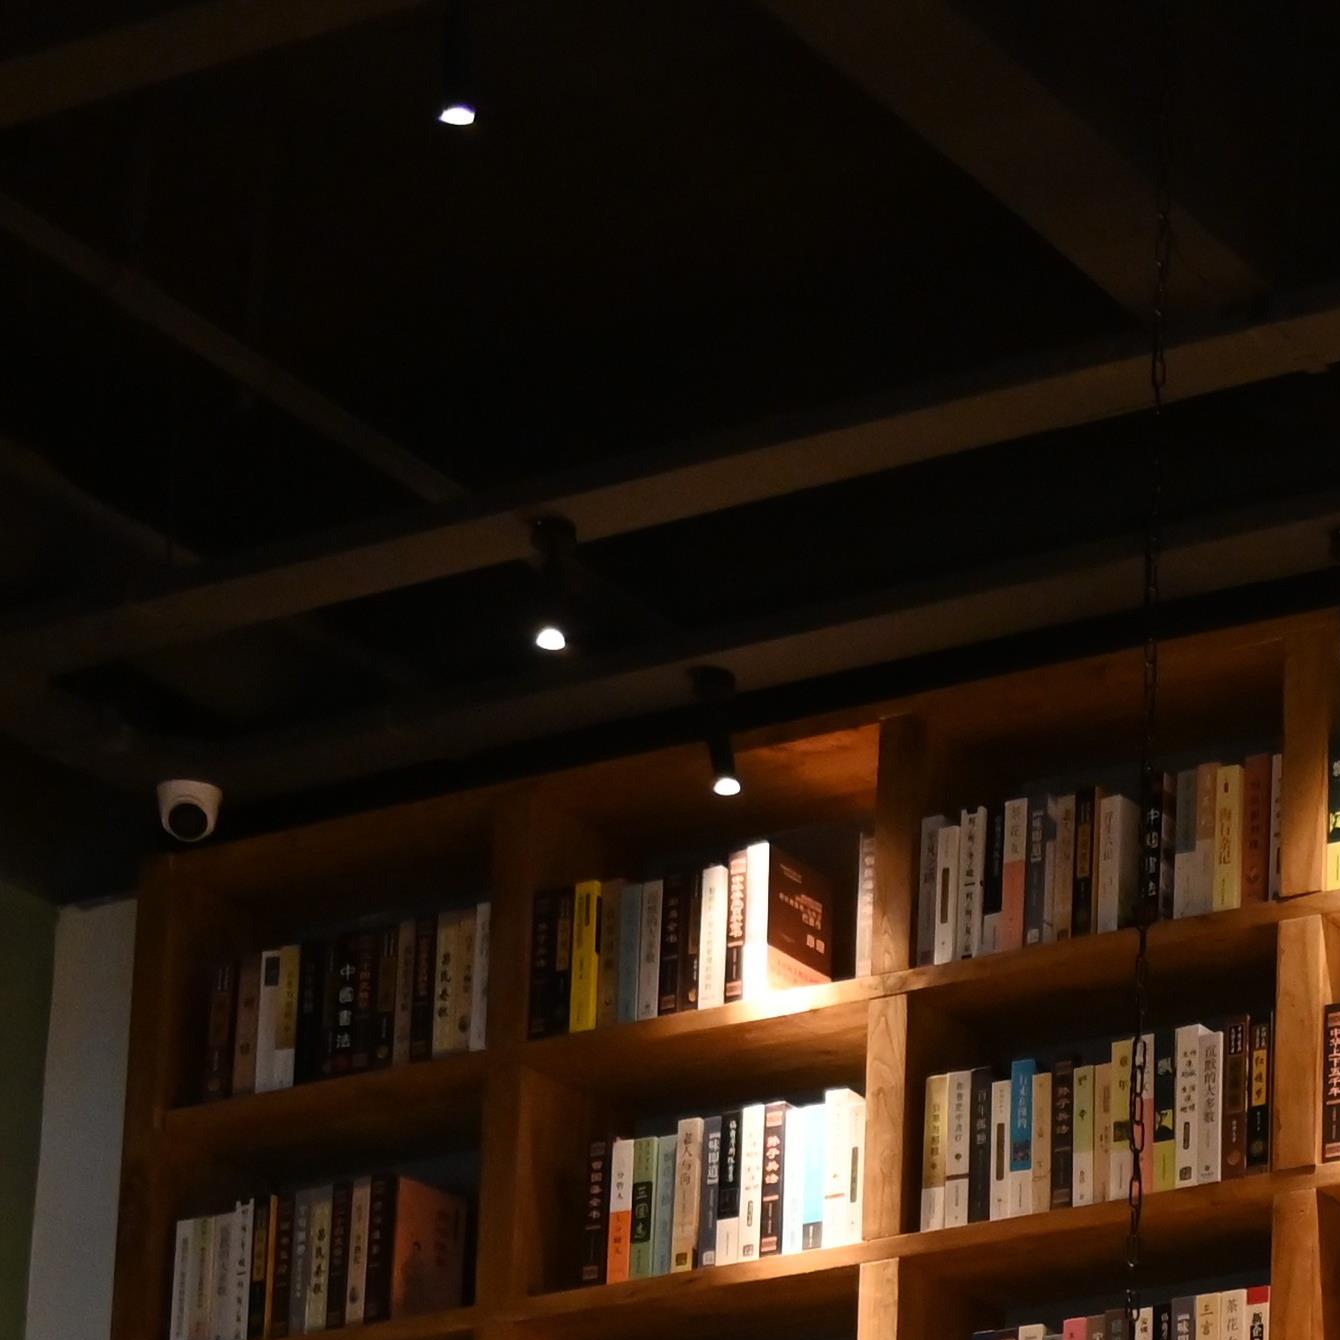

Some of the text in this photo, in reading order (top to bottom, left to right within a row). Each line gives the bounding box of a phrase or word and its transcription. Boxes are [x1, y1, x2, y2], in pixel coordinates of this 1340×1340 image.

[1203, 1044, 1217, 1123] 沉默的大多数
